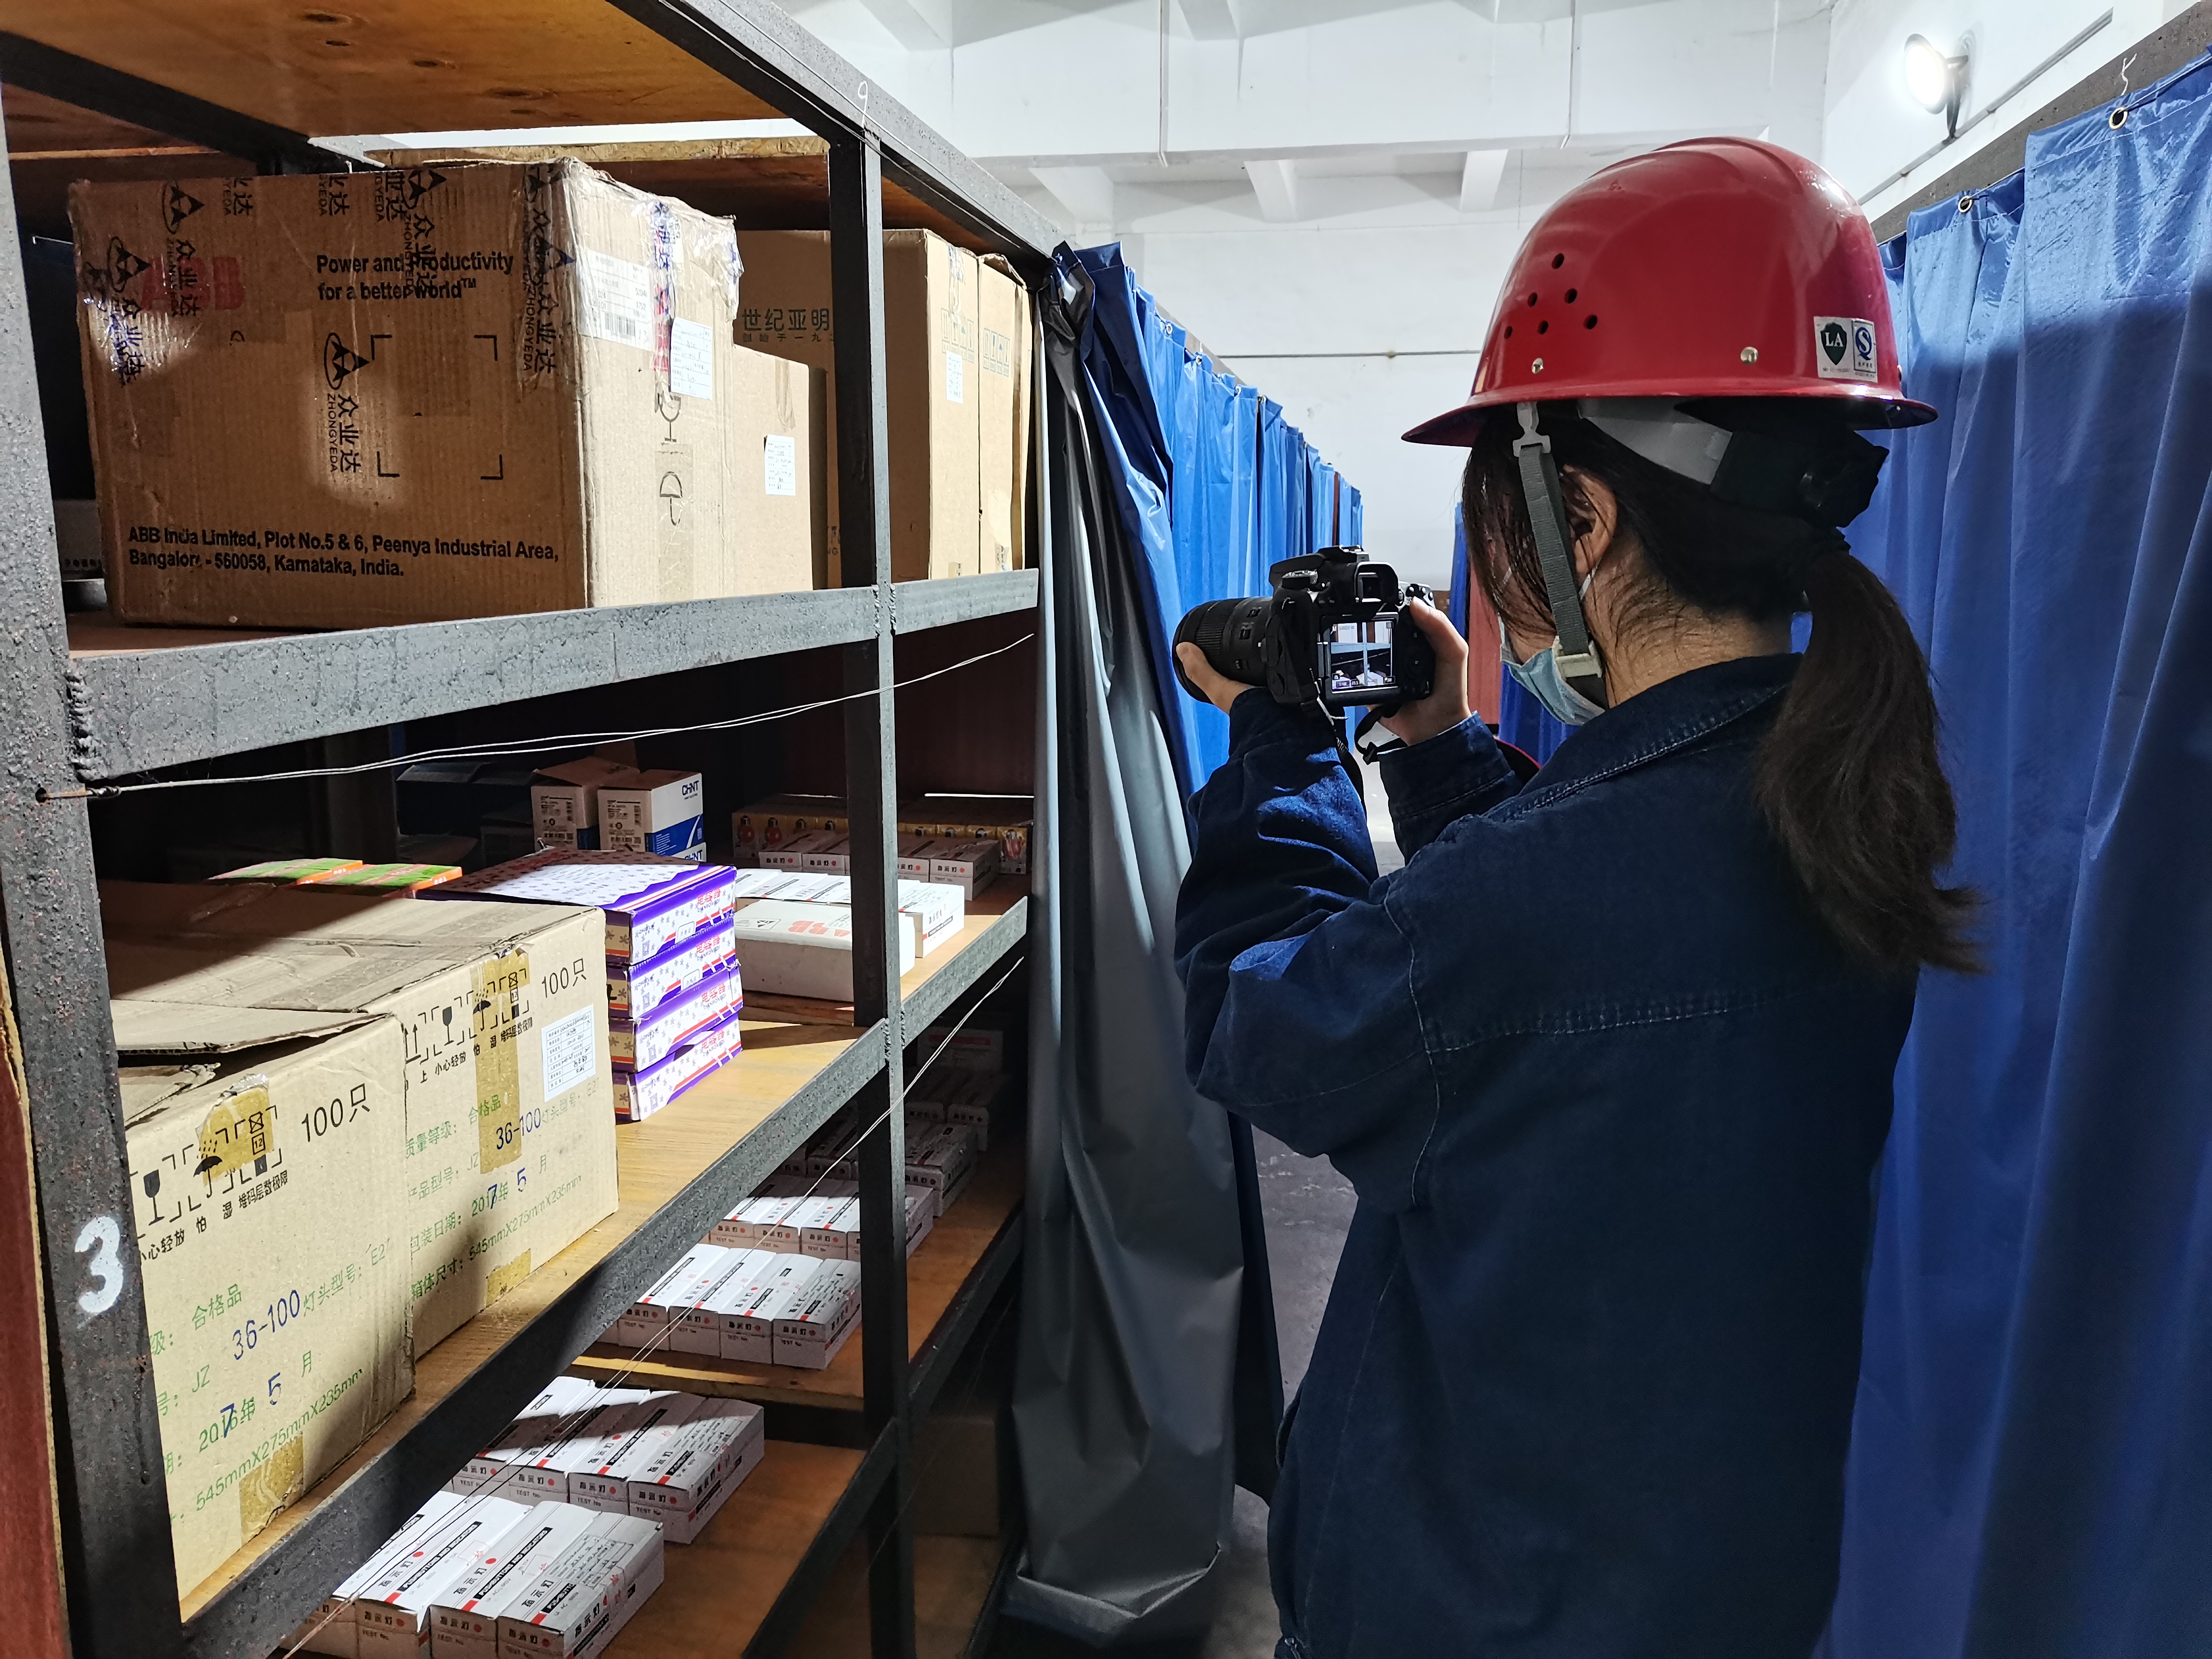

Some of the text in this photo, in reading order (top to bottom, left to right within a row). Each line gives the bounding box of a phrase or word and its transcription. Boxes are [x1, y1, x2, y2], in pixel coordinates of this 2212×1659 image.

[317, 252, 514, 275] Power and Productivity
[319, 282, 342, 301] for
[346, 287, 356, 300] a
[361, 281, 410, 300] better
[741, 308, 830, 332] 世纪亚明
[1825, 332, 1844, 347] LA
[327, 392, 339, 473] ZHONGYEDA
[337, 393, 361, 473] 众业达
[129, 526, 160, 543] ABB
[203, 529, 261, 550] Limited,
[264, 530, 296, 549] Plot
[299, 532, 335, 551] No.5
[338, 533, 350, 551] &
[354, 535, 368, 553] 6,
[372, 535, 431, 557] Peenya
[435, 538, 511, 558] Industrial
[515, 541, 559, 563] Area,
[361, 558, 404, 577] India.
[682, 780, 699, 795] CHNT
[697, 888, 721, 905] 电容器
[697, 935, 720, 953] 电容器
[541, 958, 587, 998] 100只
[701, 982, 726, 1003] 电容器
[701, 1028, 725, 1049] 电容器
[435, 1051, 466, 1075] 小心轻放
[301, 1083, 370, 1142] 100只
[469, 1094, 501, 1126] 合格品
[254, 1138, 263, 1149] 12
[496, 1107, 541, 1150] 36-100
[141, 1228, 185, 1262] 心轻放
[239, 1169, 289, 1210] 堆码层数极限
[74, 1215, 123, 1313] 3
[192, 1284, 243, 1330] 合格品
[232, 1289, 301, 1360] 36-100
[192, 1364, 210, 1393] JZ
[268, 1372, 282, 1407] 5
[301, 1350, 313, 1377] 月
[196, 1369, 363, 1512] 545mmX275mmX235mm
